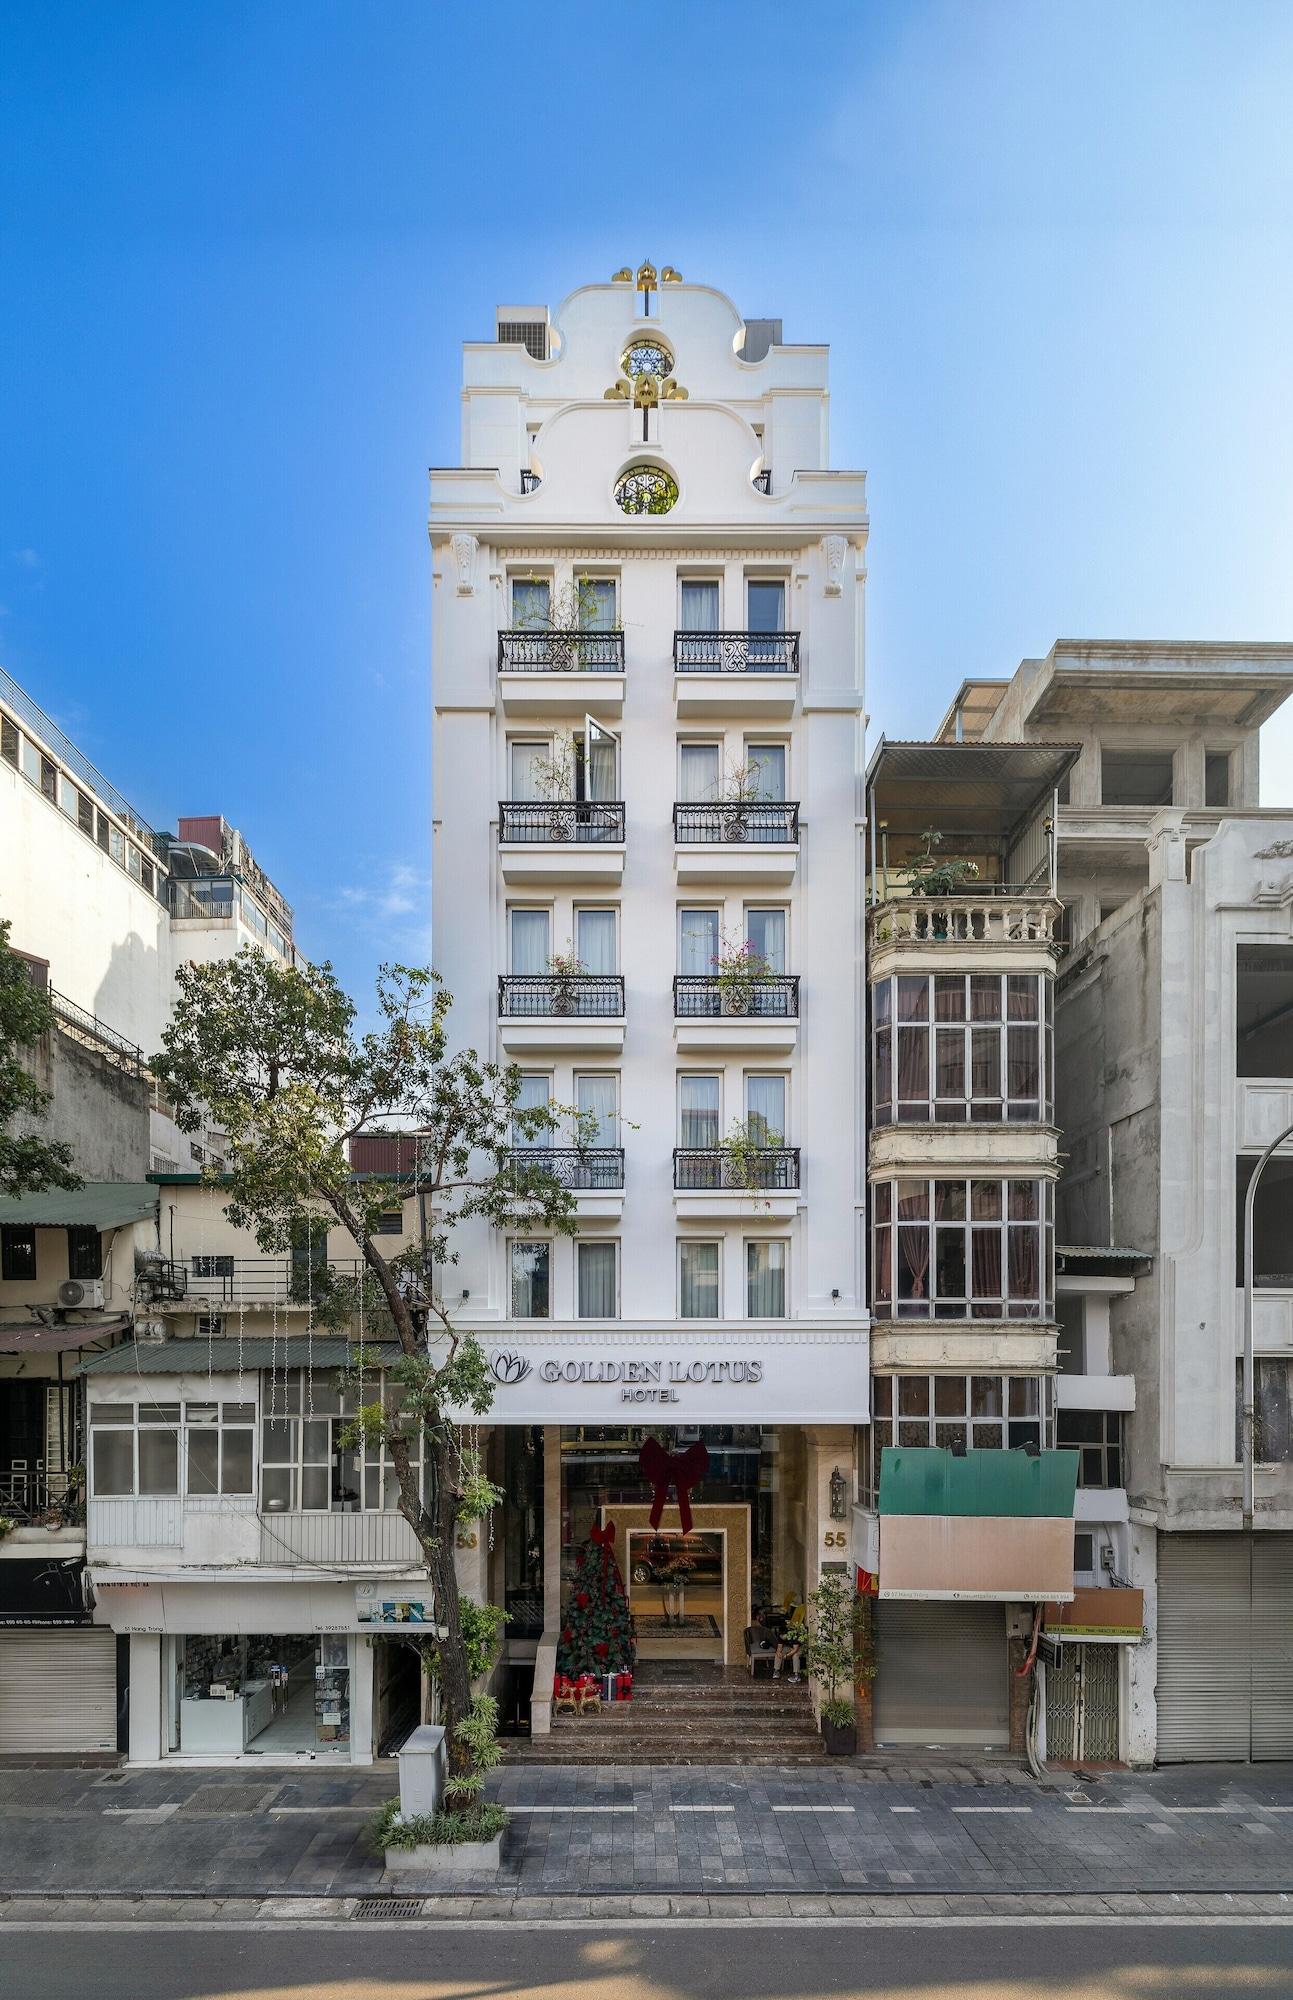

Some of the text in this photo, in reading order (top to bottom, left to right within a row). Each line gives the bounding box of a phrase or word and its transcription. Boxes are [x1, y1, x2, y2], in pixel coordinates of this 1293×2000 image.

[539, 1360, 763, 1383] GOLDEN LOTUS
[621, 1388, 680, 1402] HOTEL
[824, 1531, 847, 1548] 55
